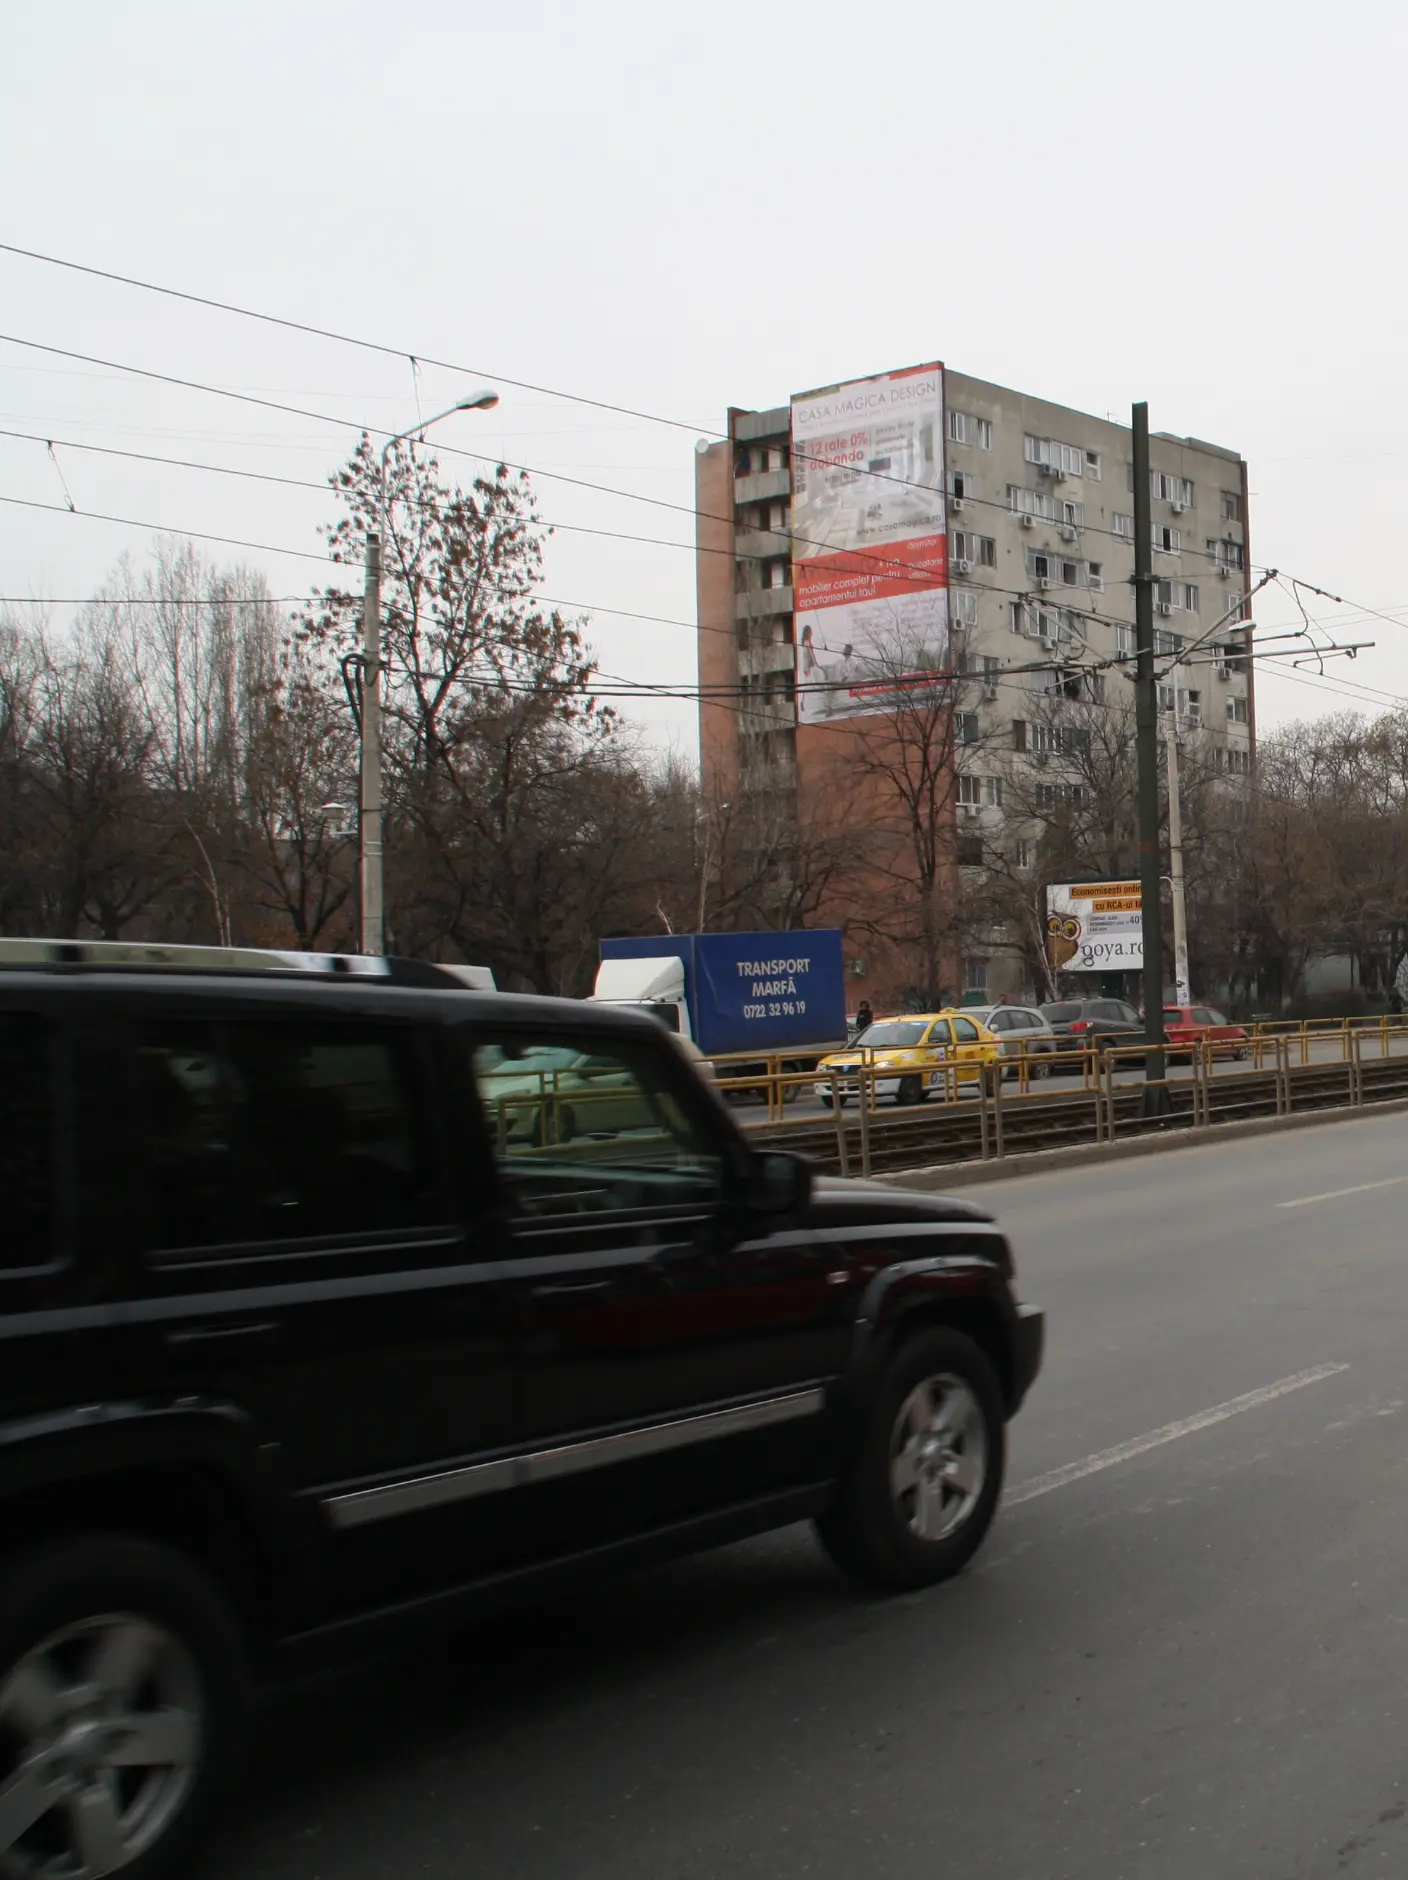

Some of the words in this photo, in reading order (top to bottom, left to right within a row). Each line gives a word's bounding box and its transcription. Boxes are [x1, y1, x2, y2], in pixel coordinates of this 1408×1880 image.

[798, 409, 831, 424] CASA
[835, 393, 887, 415] MAGICA
[890, 380, 936, 402] DESIGN
[850, 431, 867, 446] 0%
[833, 574, 870, 591] complet
[1107, 899, 1133, 910] RCA-ul
[737, 958, 810, 977] TRANSPORT
[752, 977, 797, 997] MARFĂ
[743, 1004, 766, 1019] 0722
[769, 1003, 781, 1016] 32
[782, 1001, 795, 1016] 96
[796, 1000, 806, 1015] 19
